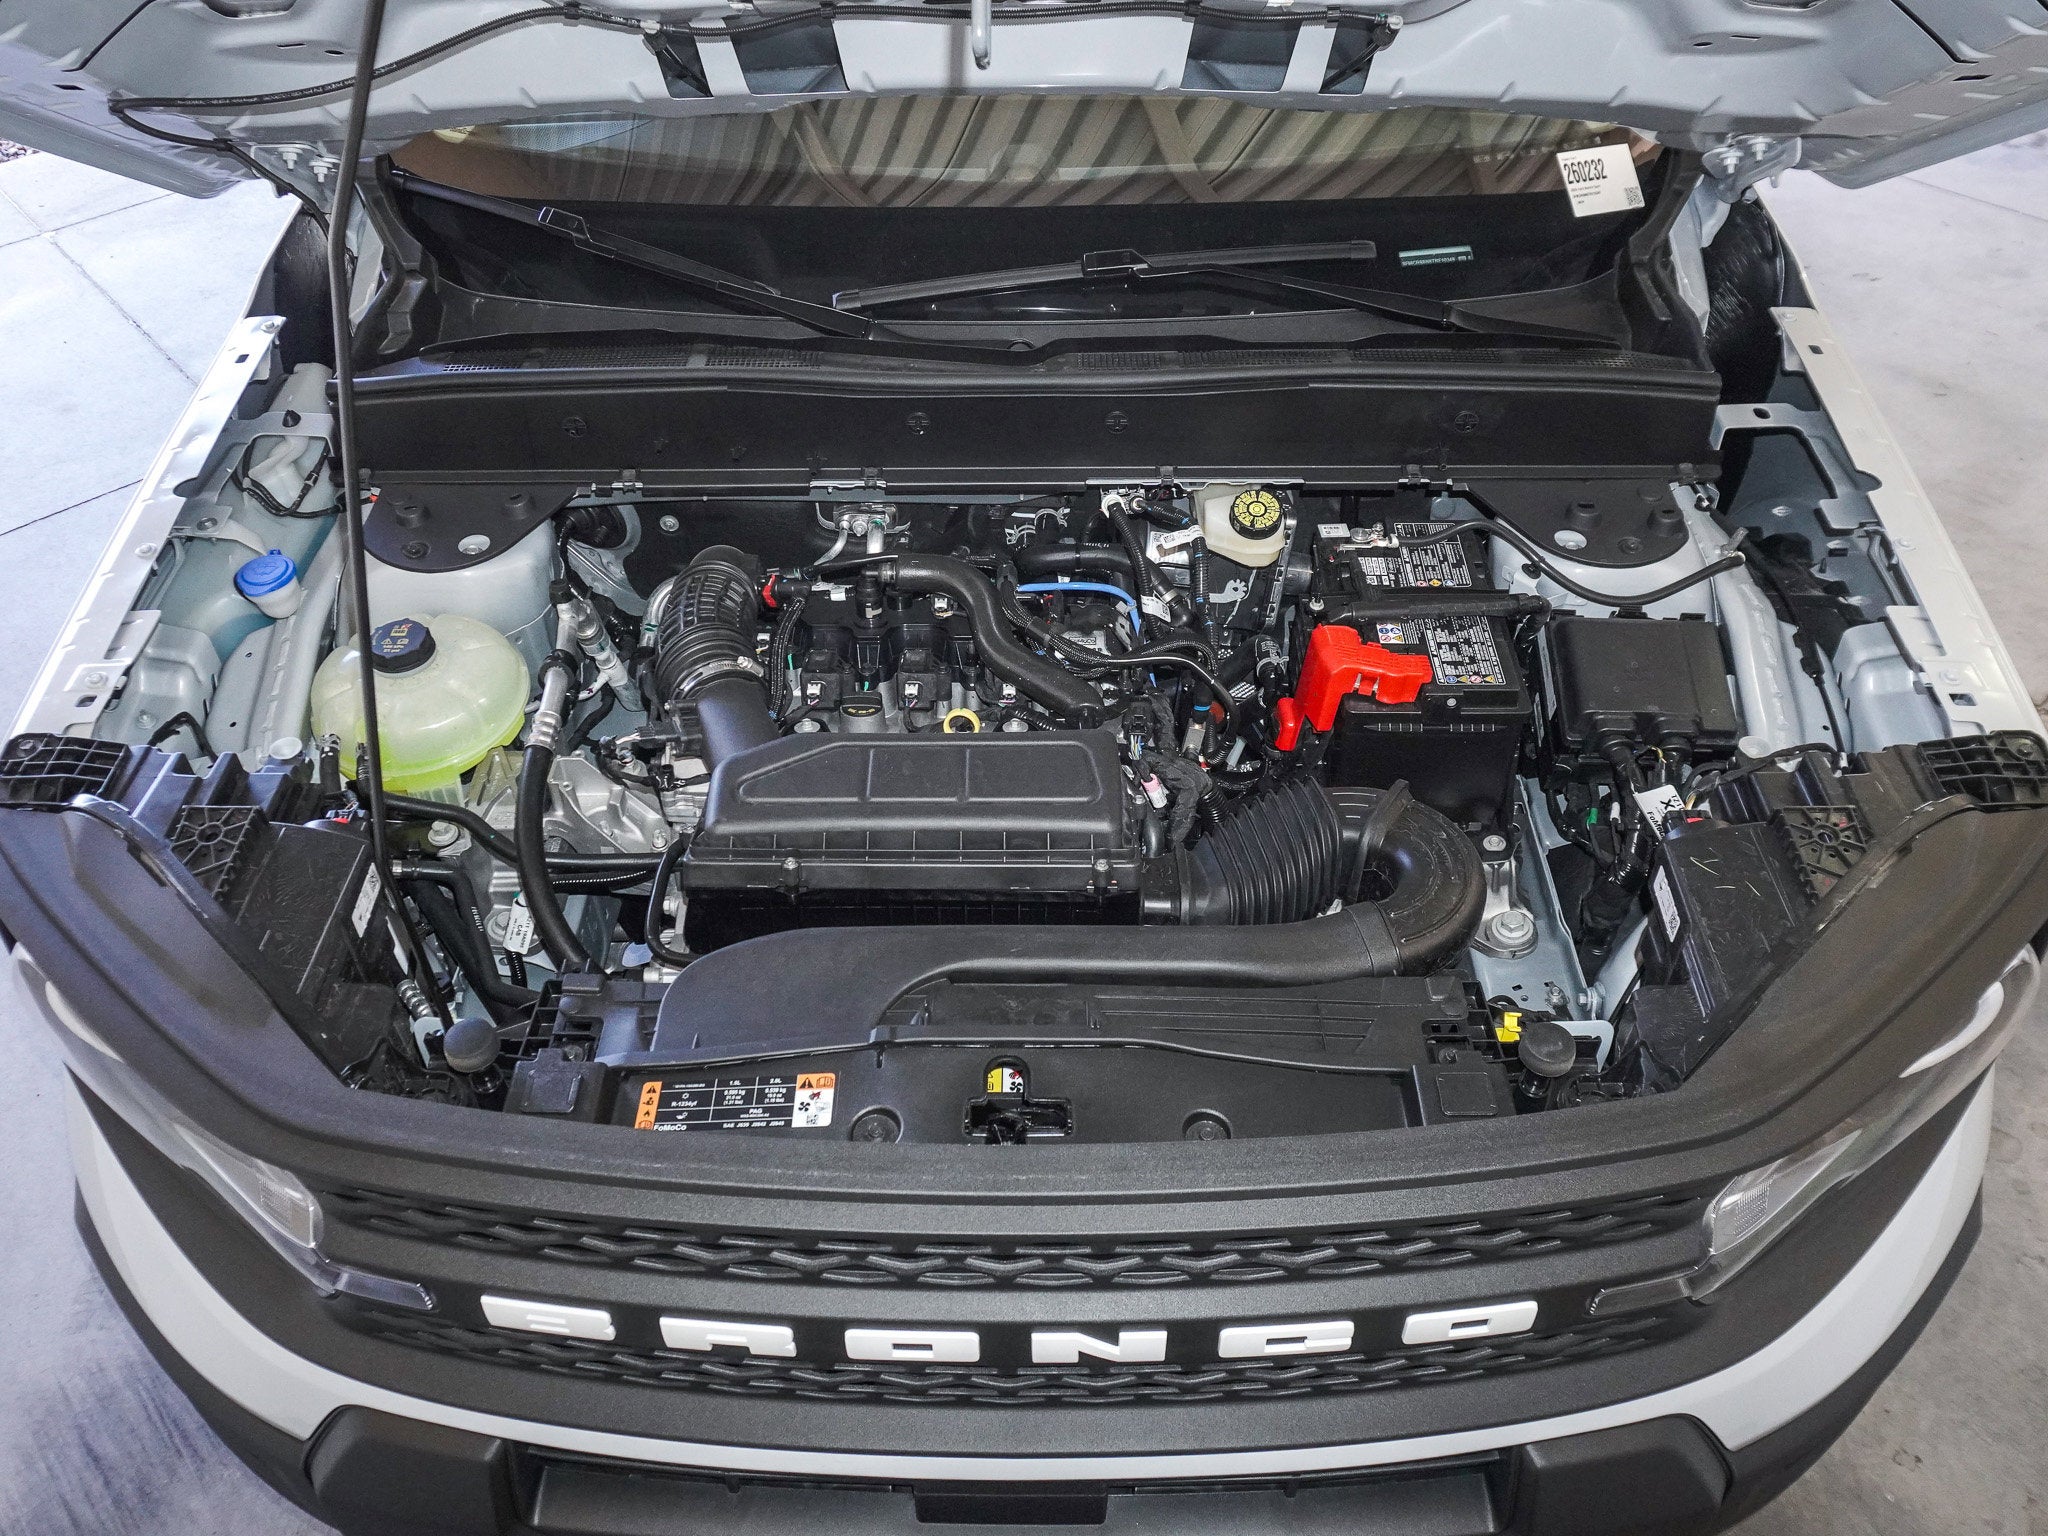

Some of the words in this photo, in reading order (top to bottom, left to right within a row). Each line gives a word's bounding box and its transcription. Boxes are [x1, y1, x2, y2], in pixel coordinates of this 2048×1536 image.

[1563, 158, 1608, 185] 260232
[1660, 798, 1676, 810] X
[479, 1293, 1540, 1364] BRONCO
